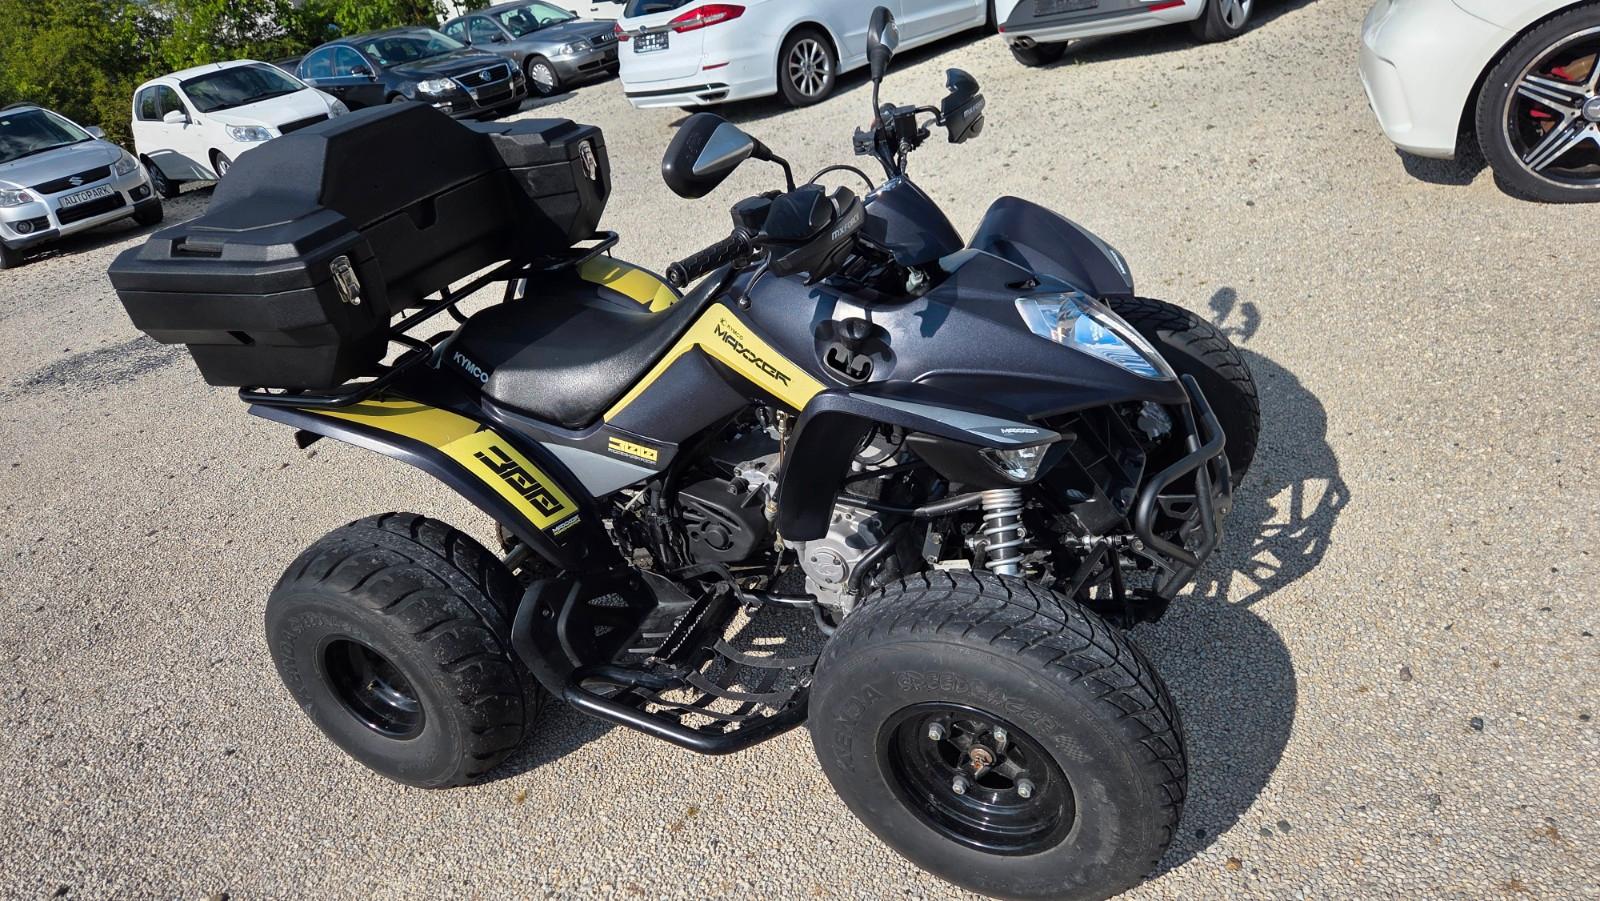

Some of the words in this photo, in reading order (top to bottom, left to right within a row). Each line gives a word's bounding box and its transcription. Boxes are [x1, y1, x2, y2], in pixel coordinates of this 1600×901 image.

[63, 185, 111, 206] AUTOPARK
[453, 351, 489, 383] KYMCO
[714, 323, 792, 388] MAXXER
[472, 445, 565, 518] 300
